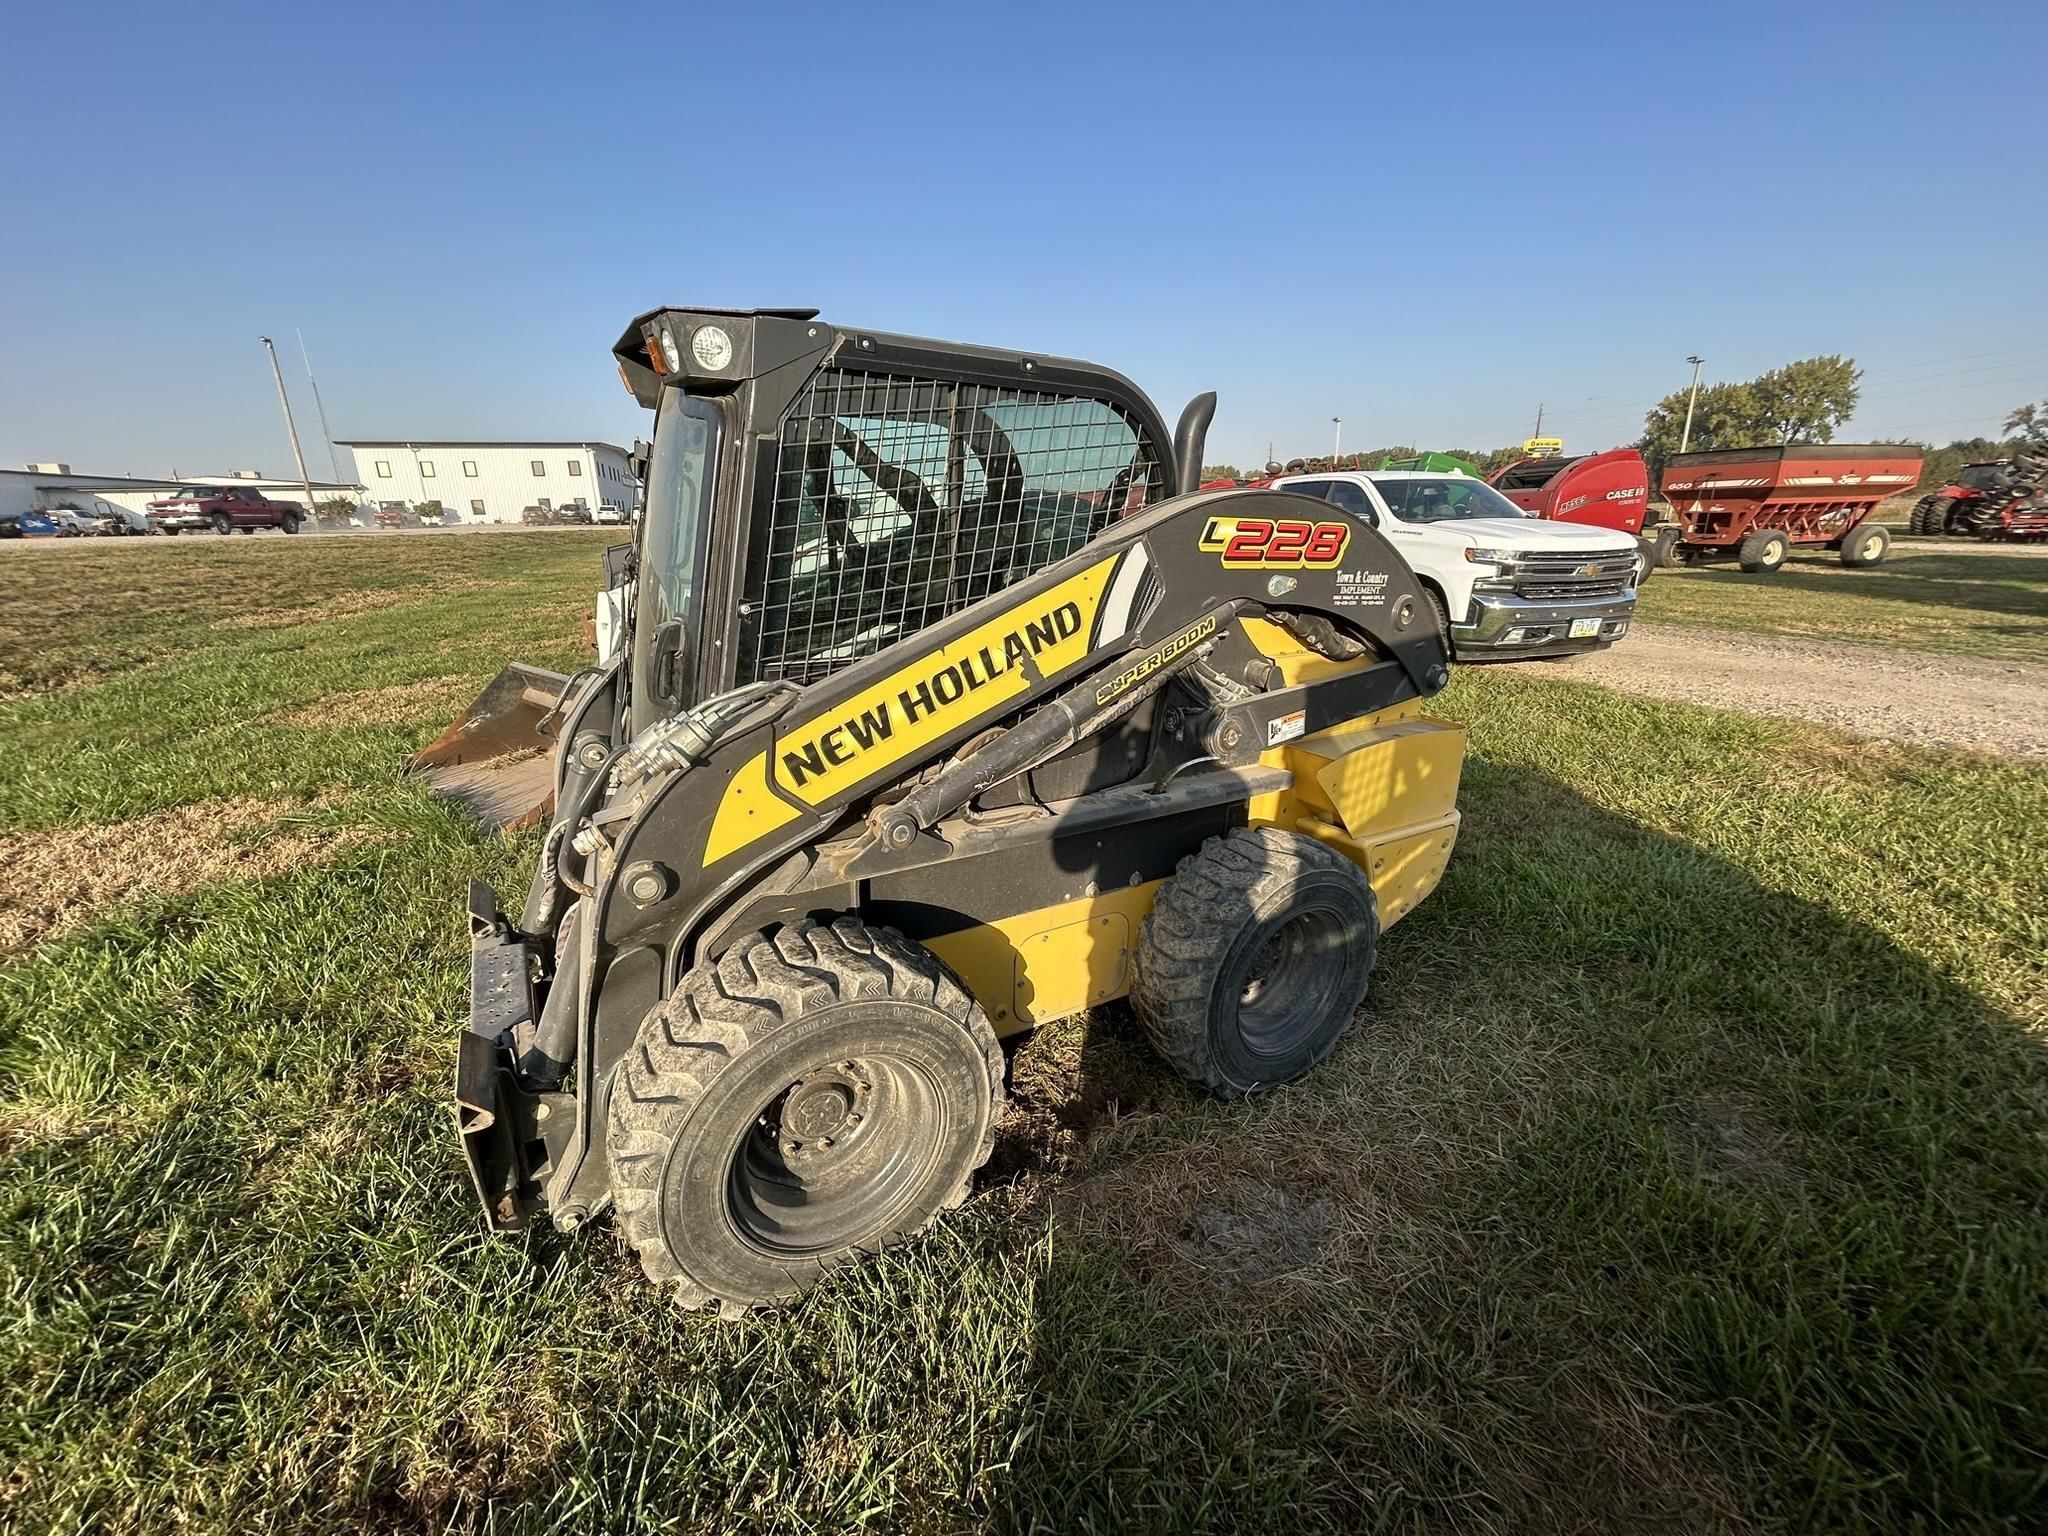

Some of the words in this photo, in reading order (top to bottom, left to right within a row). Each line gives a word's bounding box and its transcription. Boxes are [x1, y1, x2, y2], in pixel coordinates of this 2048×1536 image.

[1606, 488, 1635, 500] CASE
[1201, 519, 1349, 567] L228
[1336, 569, 1355, 584] Town
[1354, 570, 1362, 584] &
[1362, 570, 1389, 587] Country
[1340, 586, 1381, 595] IMPLEMENT
[1162, 616, 1216, 662] BOOM
[782, 701, 894, 788] NEW
[897, 601, 1082, 726] HOLLAND
